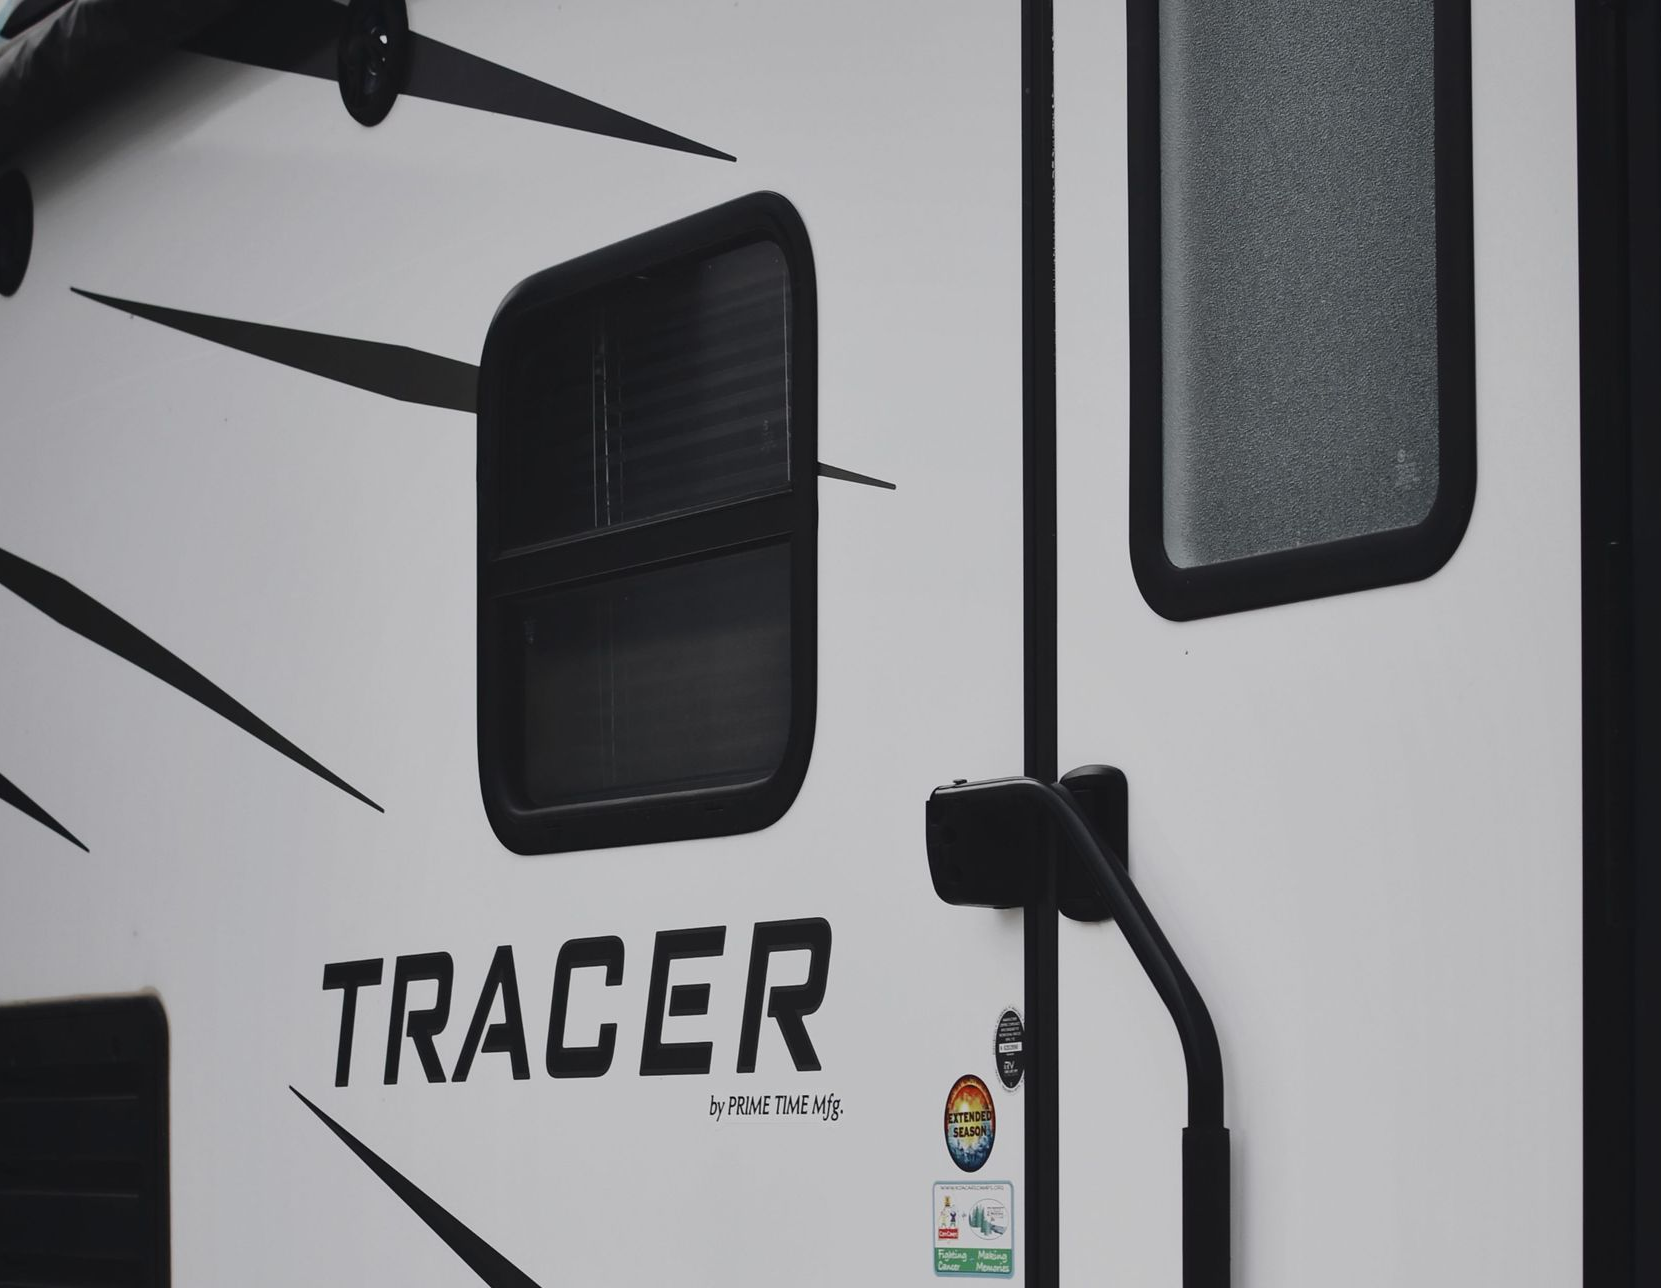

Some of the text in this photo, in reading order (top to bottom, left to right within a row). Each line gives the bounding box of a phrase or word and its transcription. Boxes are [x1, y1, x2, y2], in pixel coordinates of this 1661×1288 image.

[322, 917, 832, 1087] TRACER
[709, 1093, 844, 1122] by PRIME TIME Mfg.
[948, 1110, 992, 1124] EXTENDED
[953, 1125, 987, 1138] SEASON
[938, 1249, 967, 1262] Fighting
[978, 1250, 1007, 1263] Making
[938, 1261, 960, 1271] Cancer
[976, 1262, 1010, 1272] Memories
